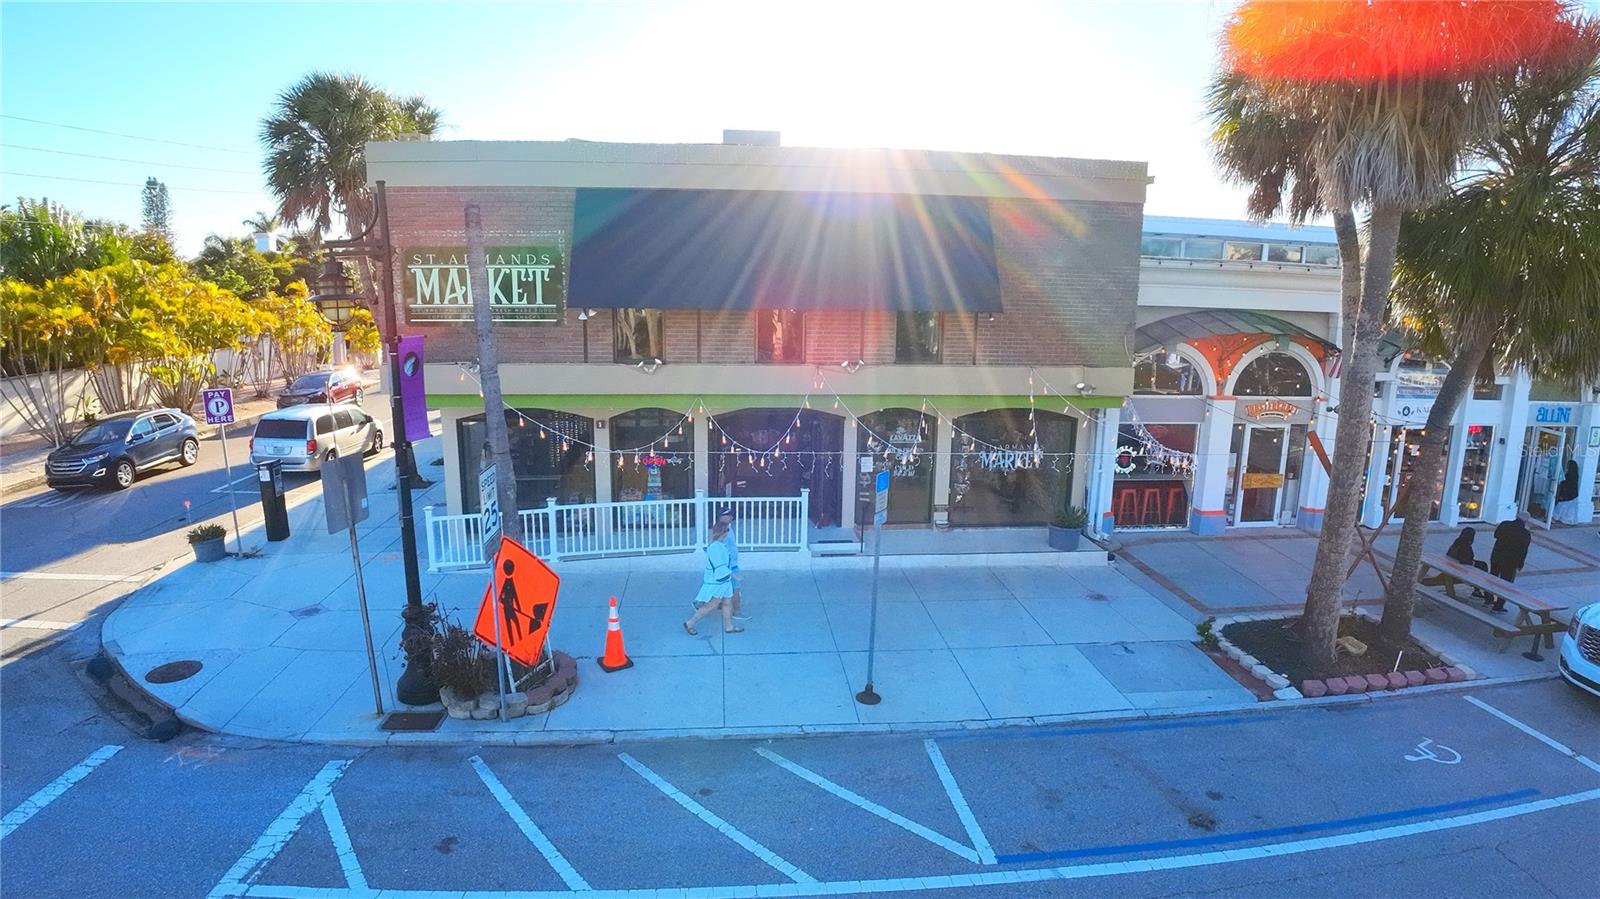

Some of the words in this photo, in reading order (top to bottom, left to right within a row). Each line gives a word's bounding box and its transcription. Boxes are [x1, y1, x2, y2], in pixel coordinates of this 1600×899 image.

[215, 401, 225, 413] P
[207, 415, 233, 423] HERE
[642, 457, 668, 465] OPEN
[483, 500, 498, 534] 25
